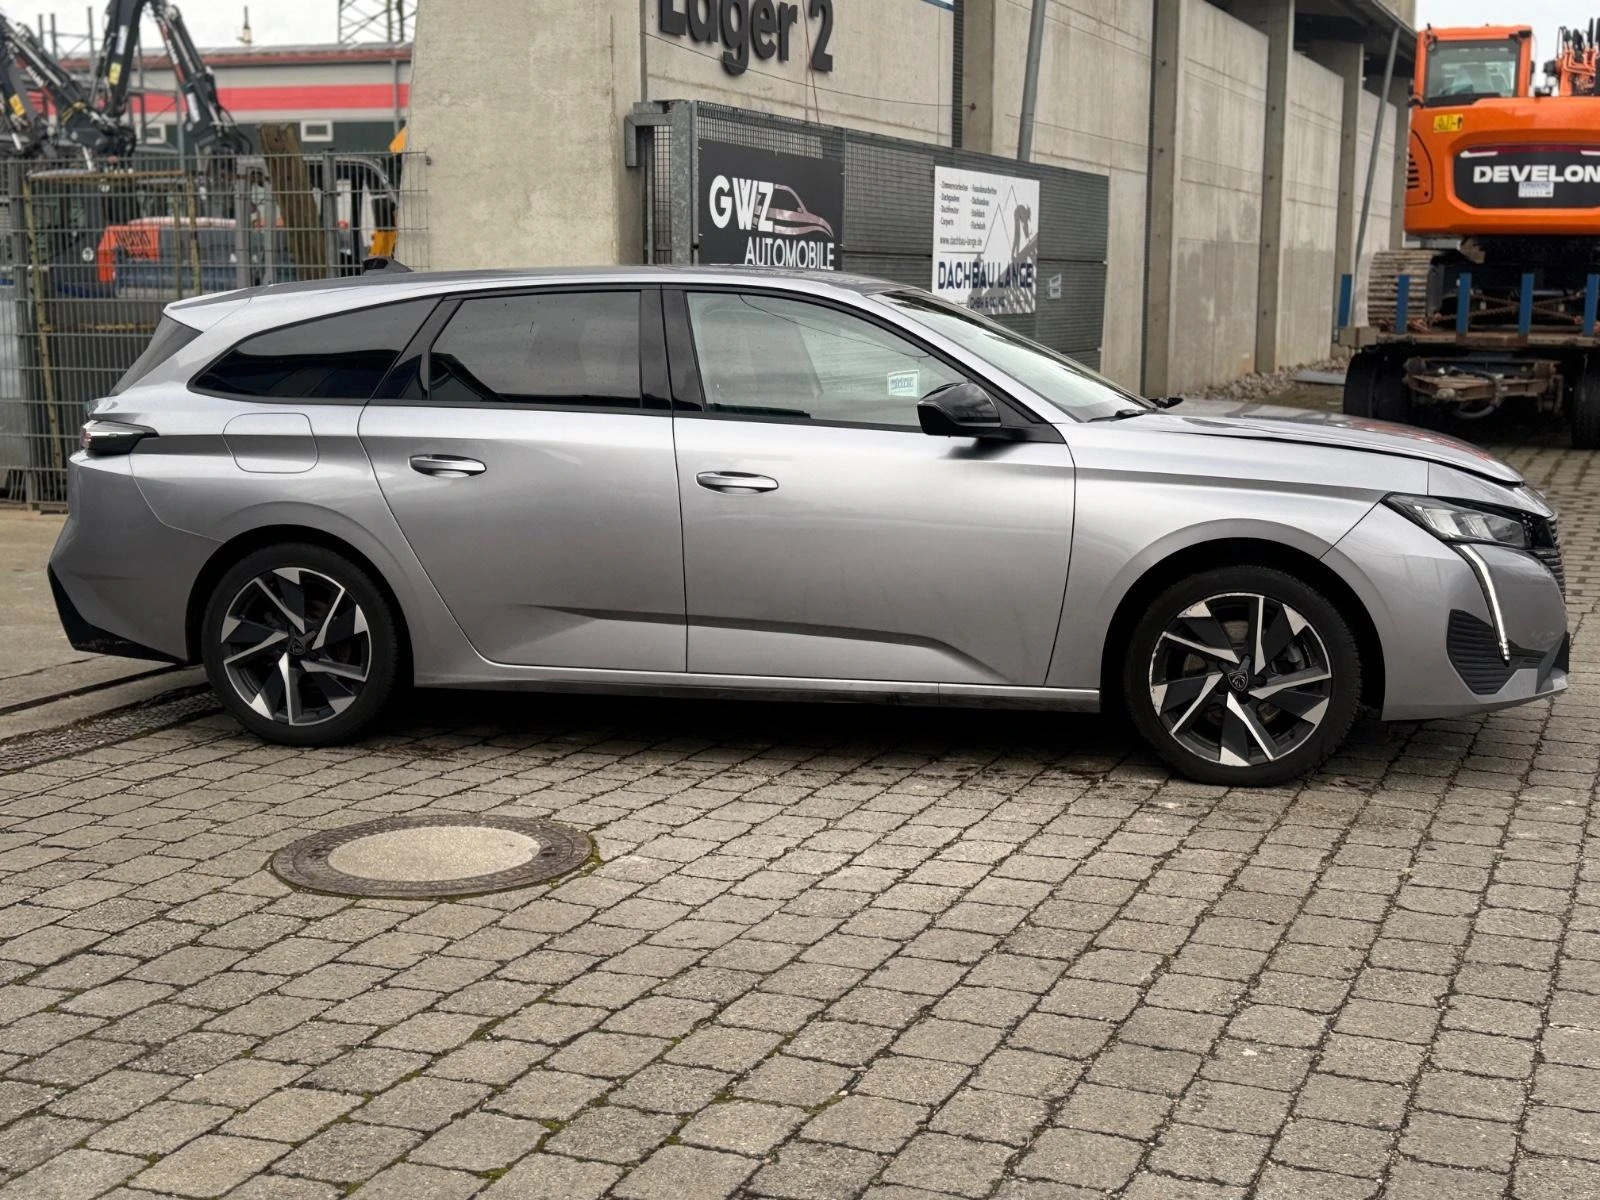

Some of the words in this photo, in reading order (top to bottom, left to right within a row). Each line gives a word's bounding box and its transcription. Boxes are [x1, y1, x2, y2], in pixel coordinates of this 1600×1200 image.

[809, 0, 833, 72] 2
[1473, 164, 1600, 183] DEVELON
[709, 174, 774, 233] GWZ
[744, 236, 835, 270] AUTOMOBILE
[938, 261, 995, 290] DACHBAU
[998, 261, 1033, 289] LANGE
